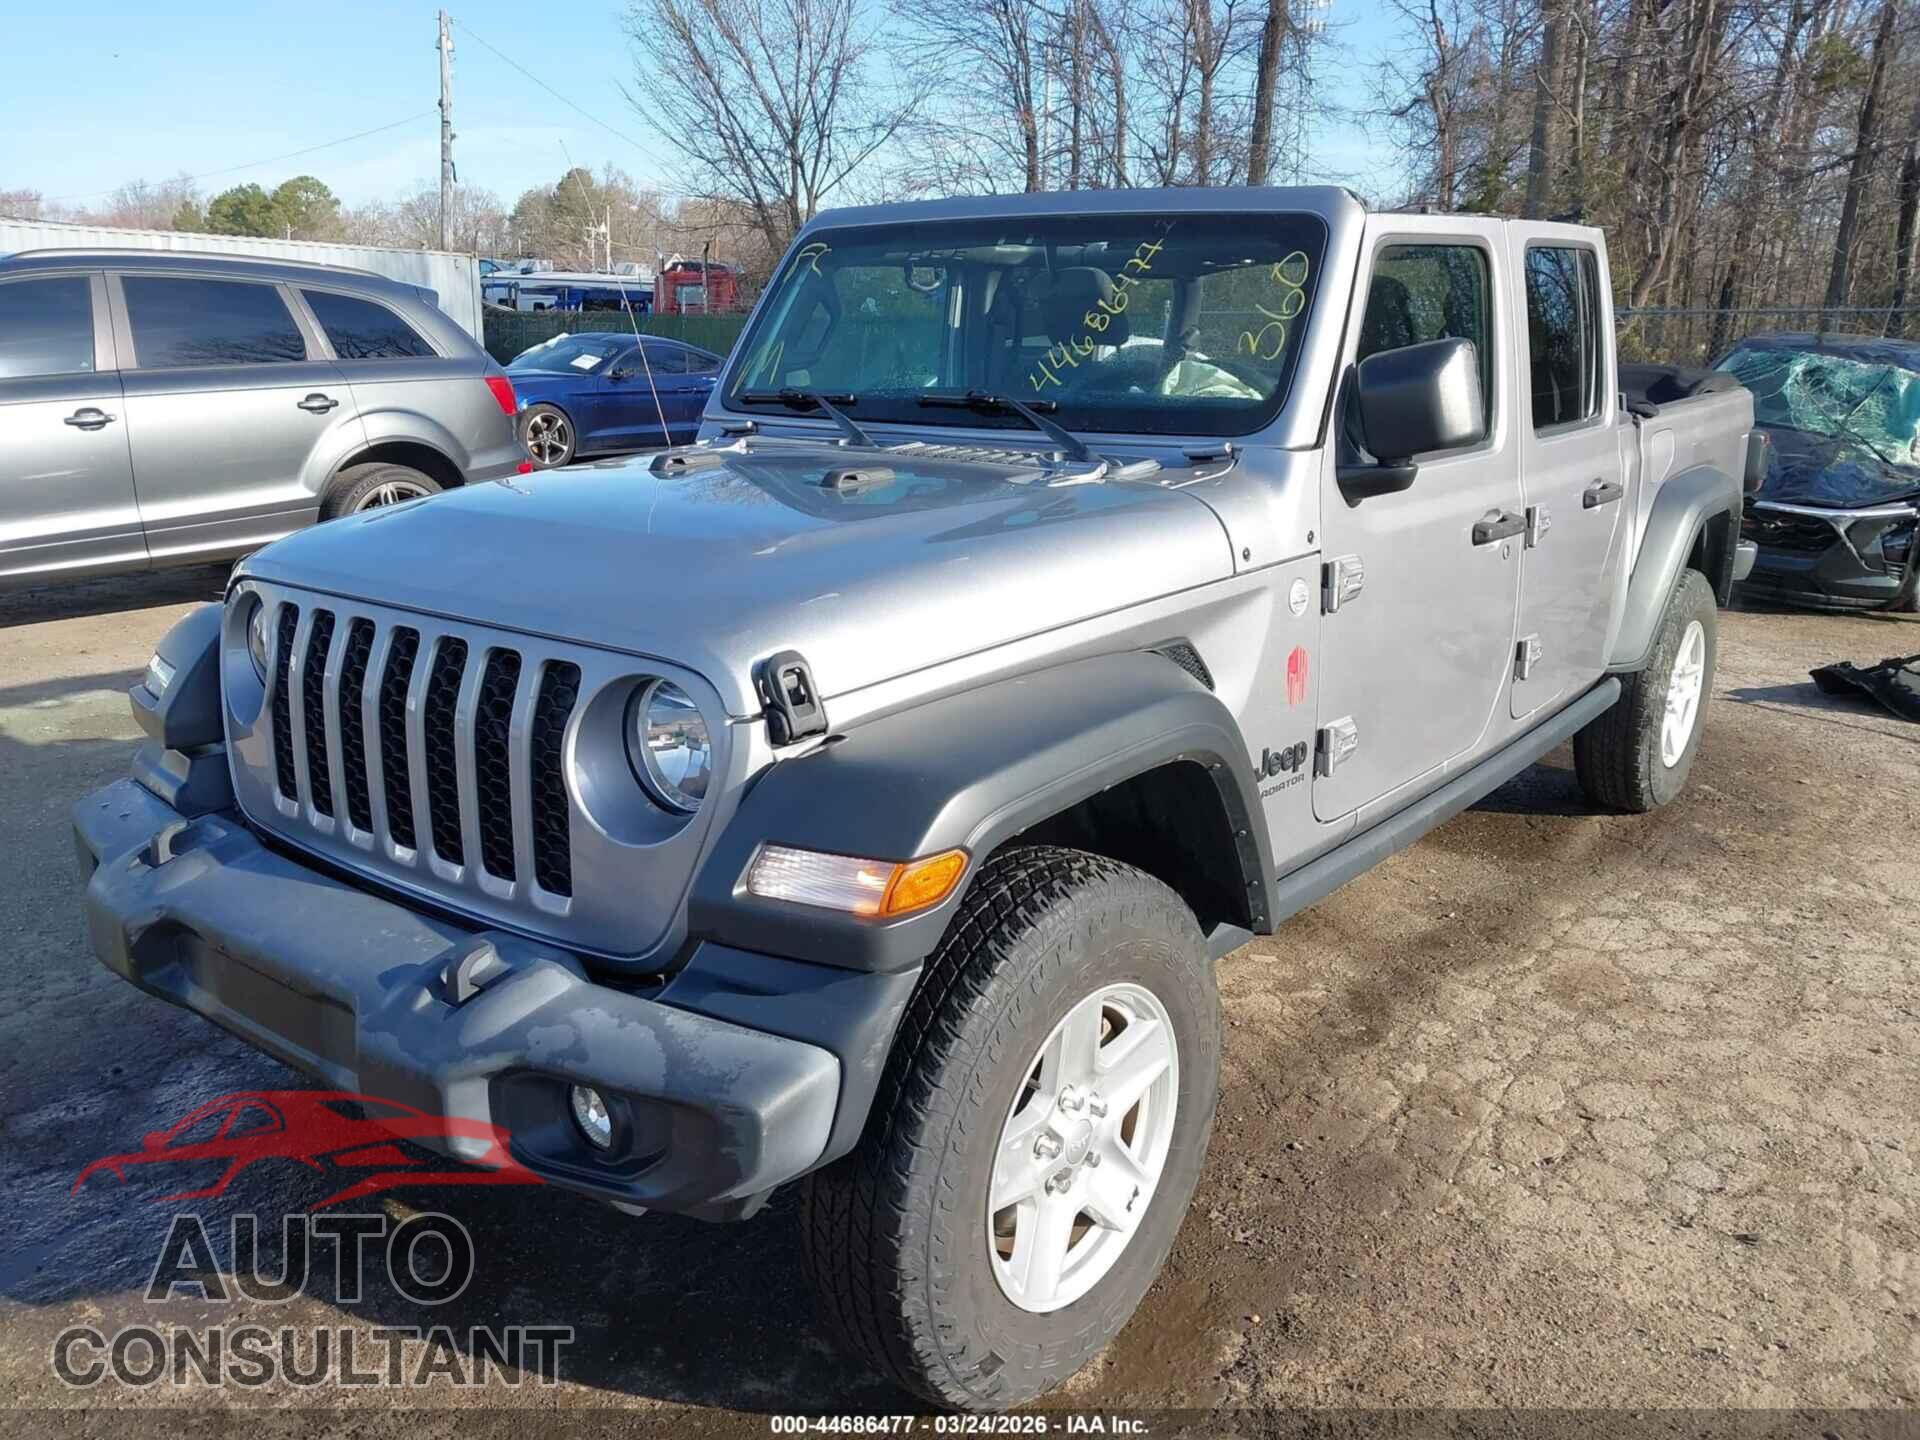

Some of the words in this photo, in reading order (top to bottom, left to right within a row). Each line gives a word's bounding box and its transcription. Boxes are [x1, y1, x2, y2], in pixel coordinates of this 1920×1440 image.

[1029, 238, 1164, 393] 44686477
[1238, 250, 1310, 360] 360
[1254, 741, 1307, 782] Jeep
[1260, 773, 1305, 798] ADIATOR
